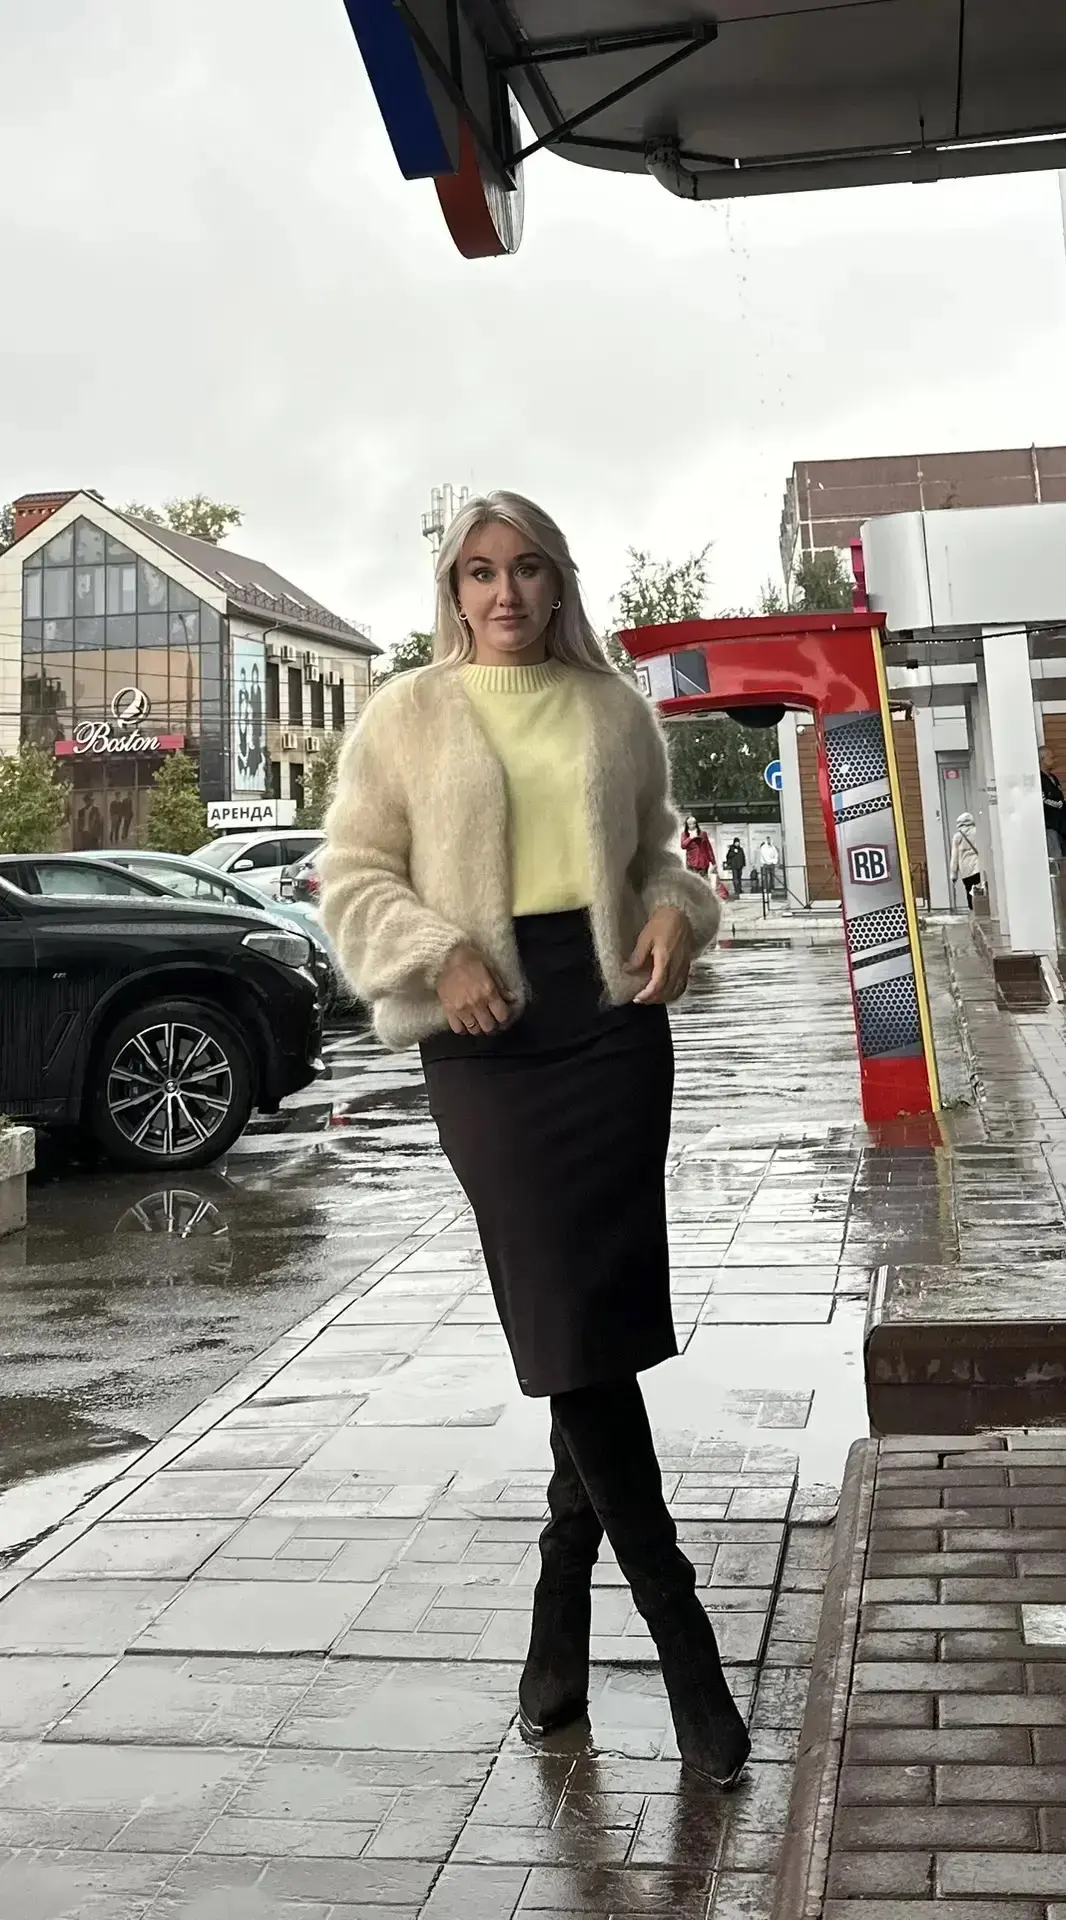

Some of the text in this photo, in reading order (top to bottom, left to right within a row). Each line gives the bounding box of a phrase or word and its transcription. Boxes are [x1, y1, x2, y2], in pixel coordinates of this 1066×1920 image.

[73, 721, 160, 754] Boston
[210, 806, 273, 822] АРЕНДА
[853, 850, 885, 879] RB
